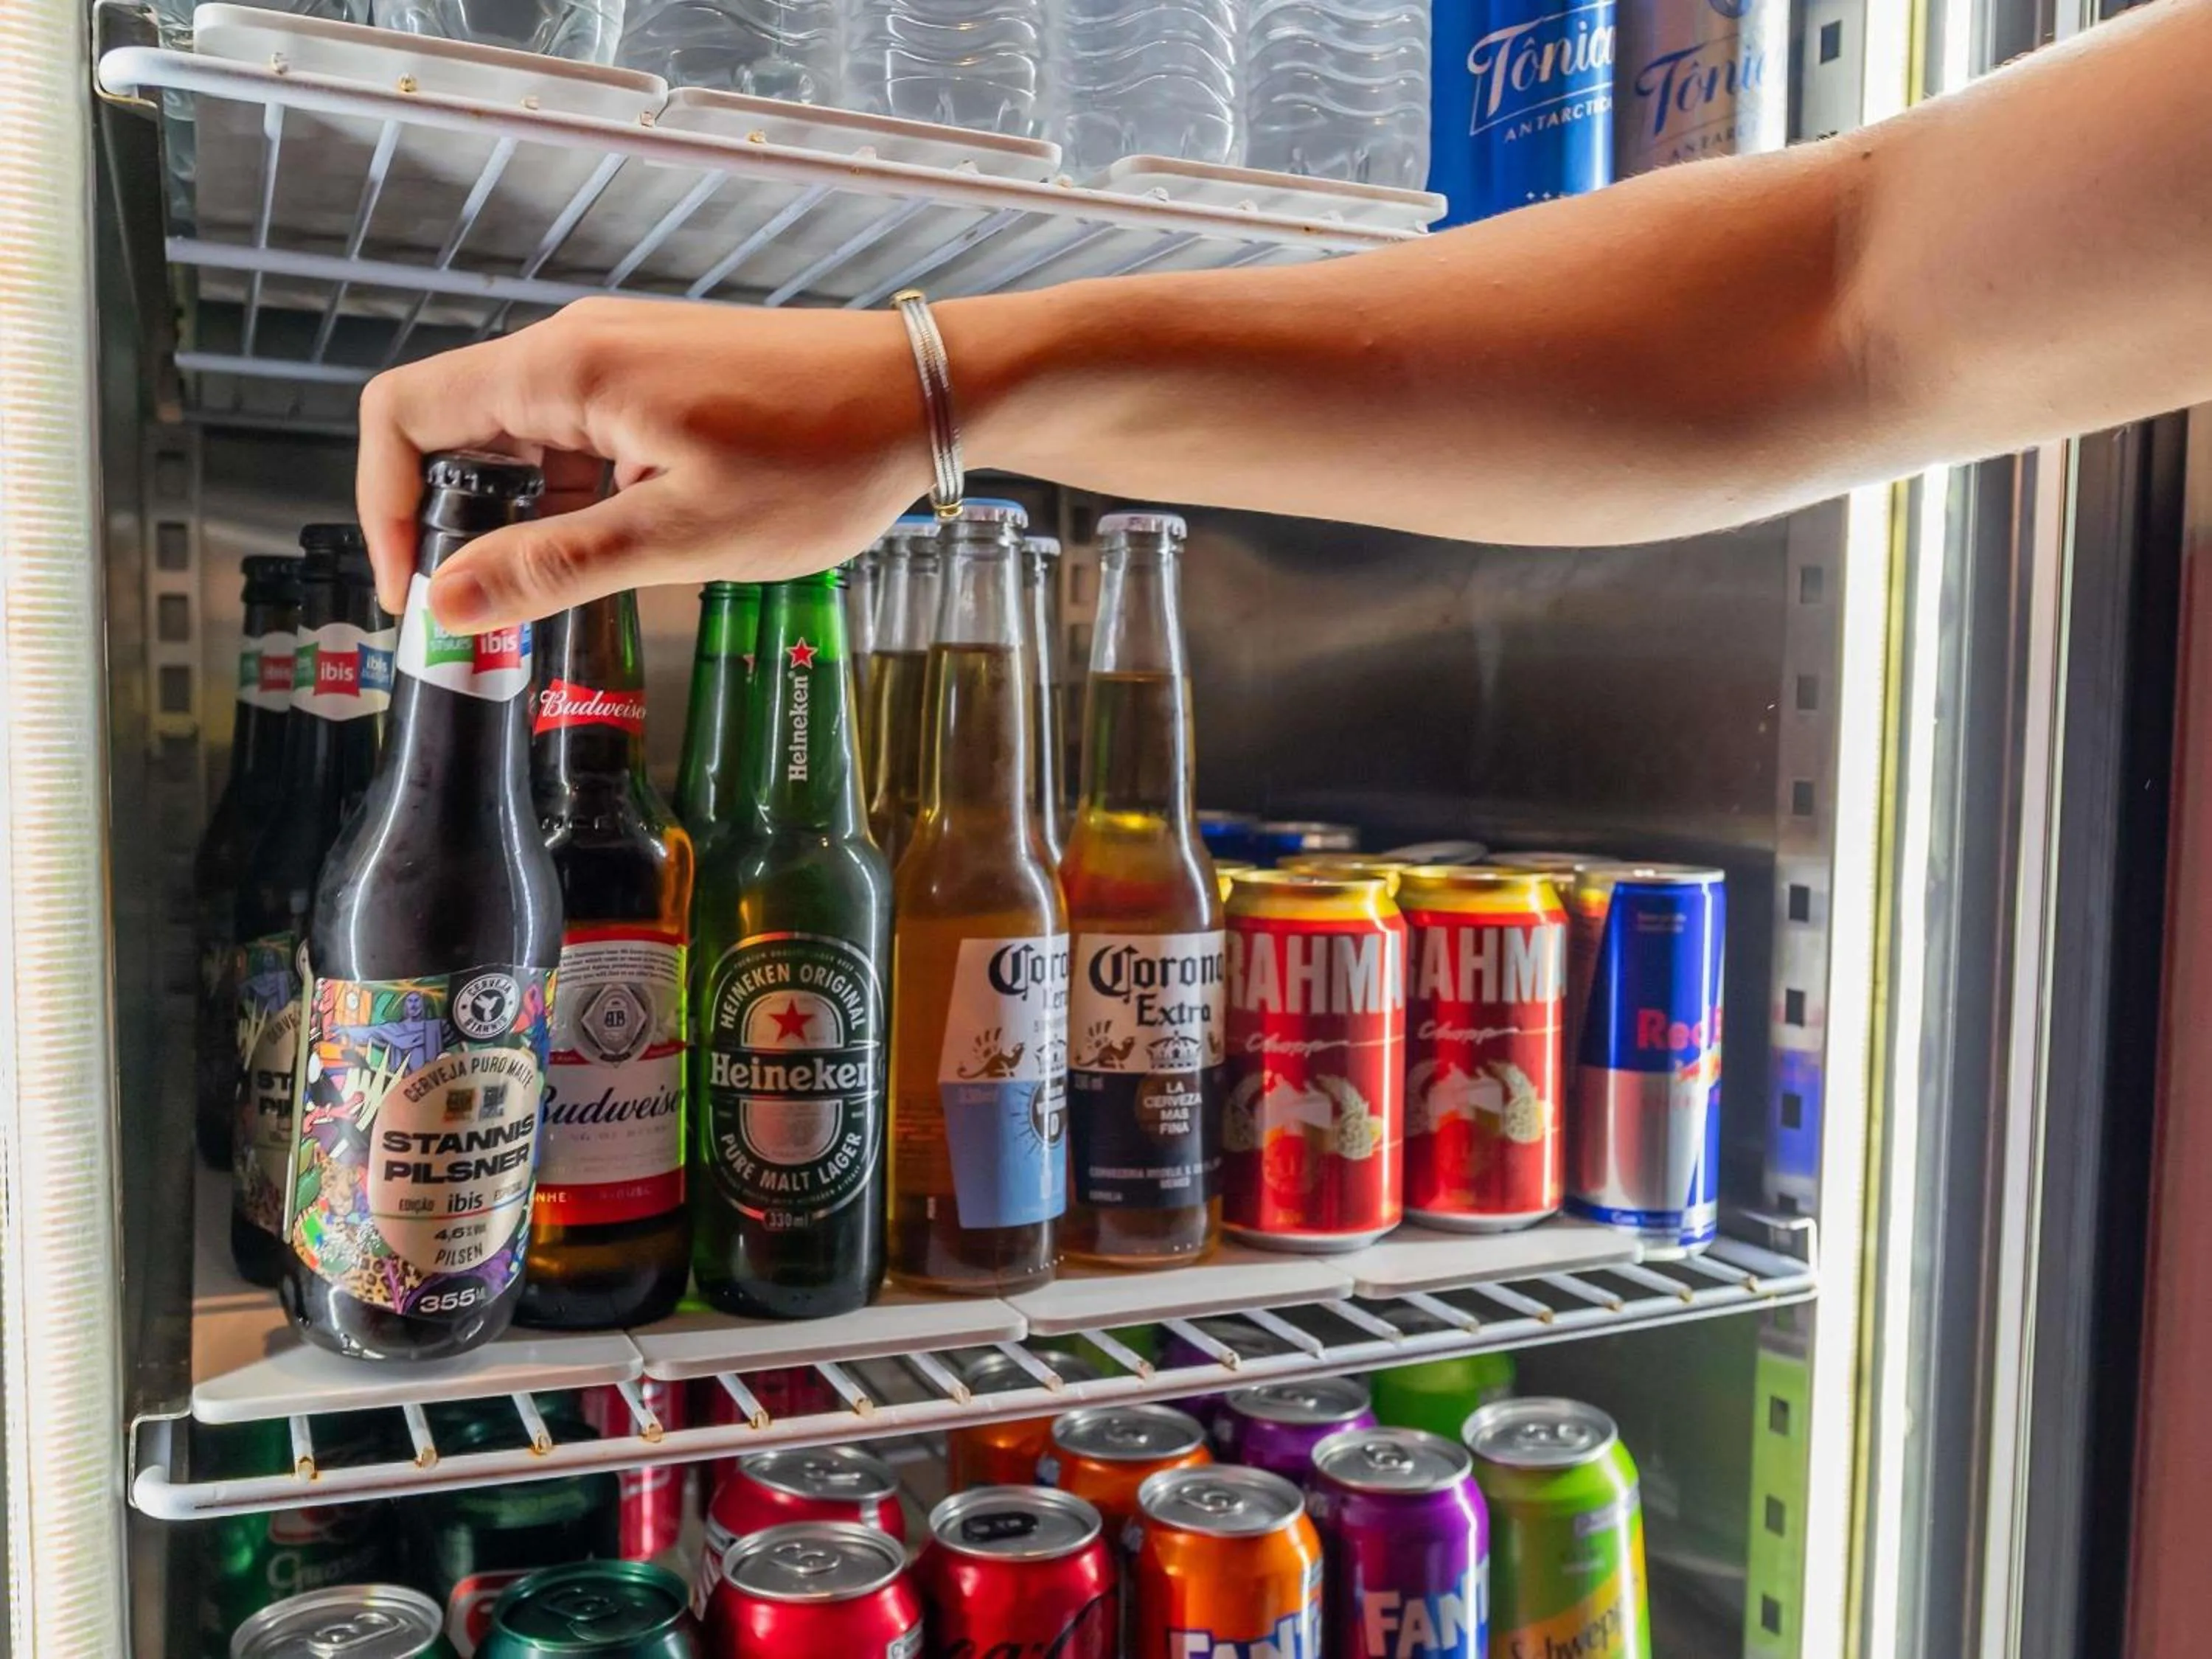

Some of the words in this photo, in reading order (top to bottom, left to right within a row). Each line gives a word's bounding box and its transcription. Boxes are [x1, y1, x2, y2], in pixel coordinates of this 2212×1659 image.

[320, 661, 354, 681] ibis
[787, 674, 809, 782] Heineken
[720, 961, 791, 1030] HEINEKEN
[800, 964, 867, 1032] ORIGINAL
[1136, 993, 1211, 1027] Extra
[403, 1061, 467, 1103] CERVEJA
[471, 1056, 507, 1074] PURO
[508, 1059, 534, 1088] MALTE
[1166, 1081, 1185, 1093] LA
[1144, 1092, 1203, 1108] CERVEZA
[383, 1113, 535, 1155] STANNIS
[1159, 1121, 1190, 1135] FINA
[384, 1143, 530, 1184] PILSNER
[720, 1133, 757, 1180] PURE
[759, 1169, 811, 1192] MALT
[816, 1132, 863, 1186] LAGER
[447, 1191, 484, 1214] ibis
[434, 1242, 483, 1267] PILSEN
